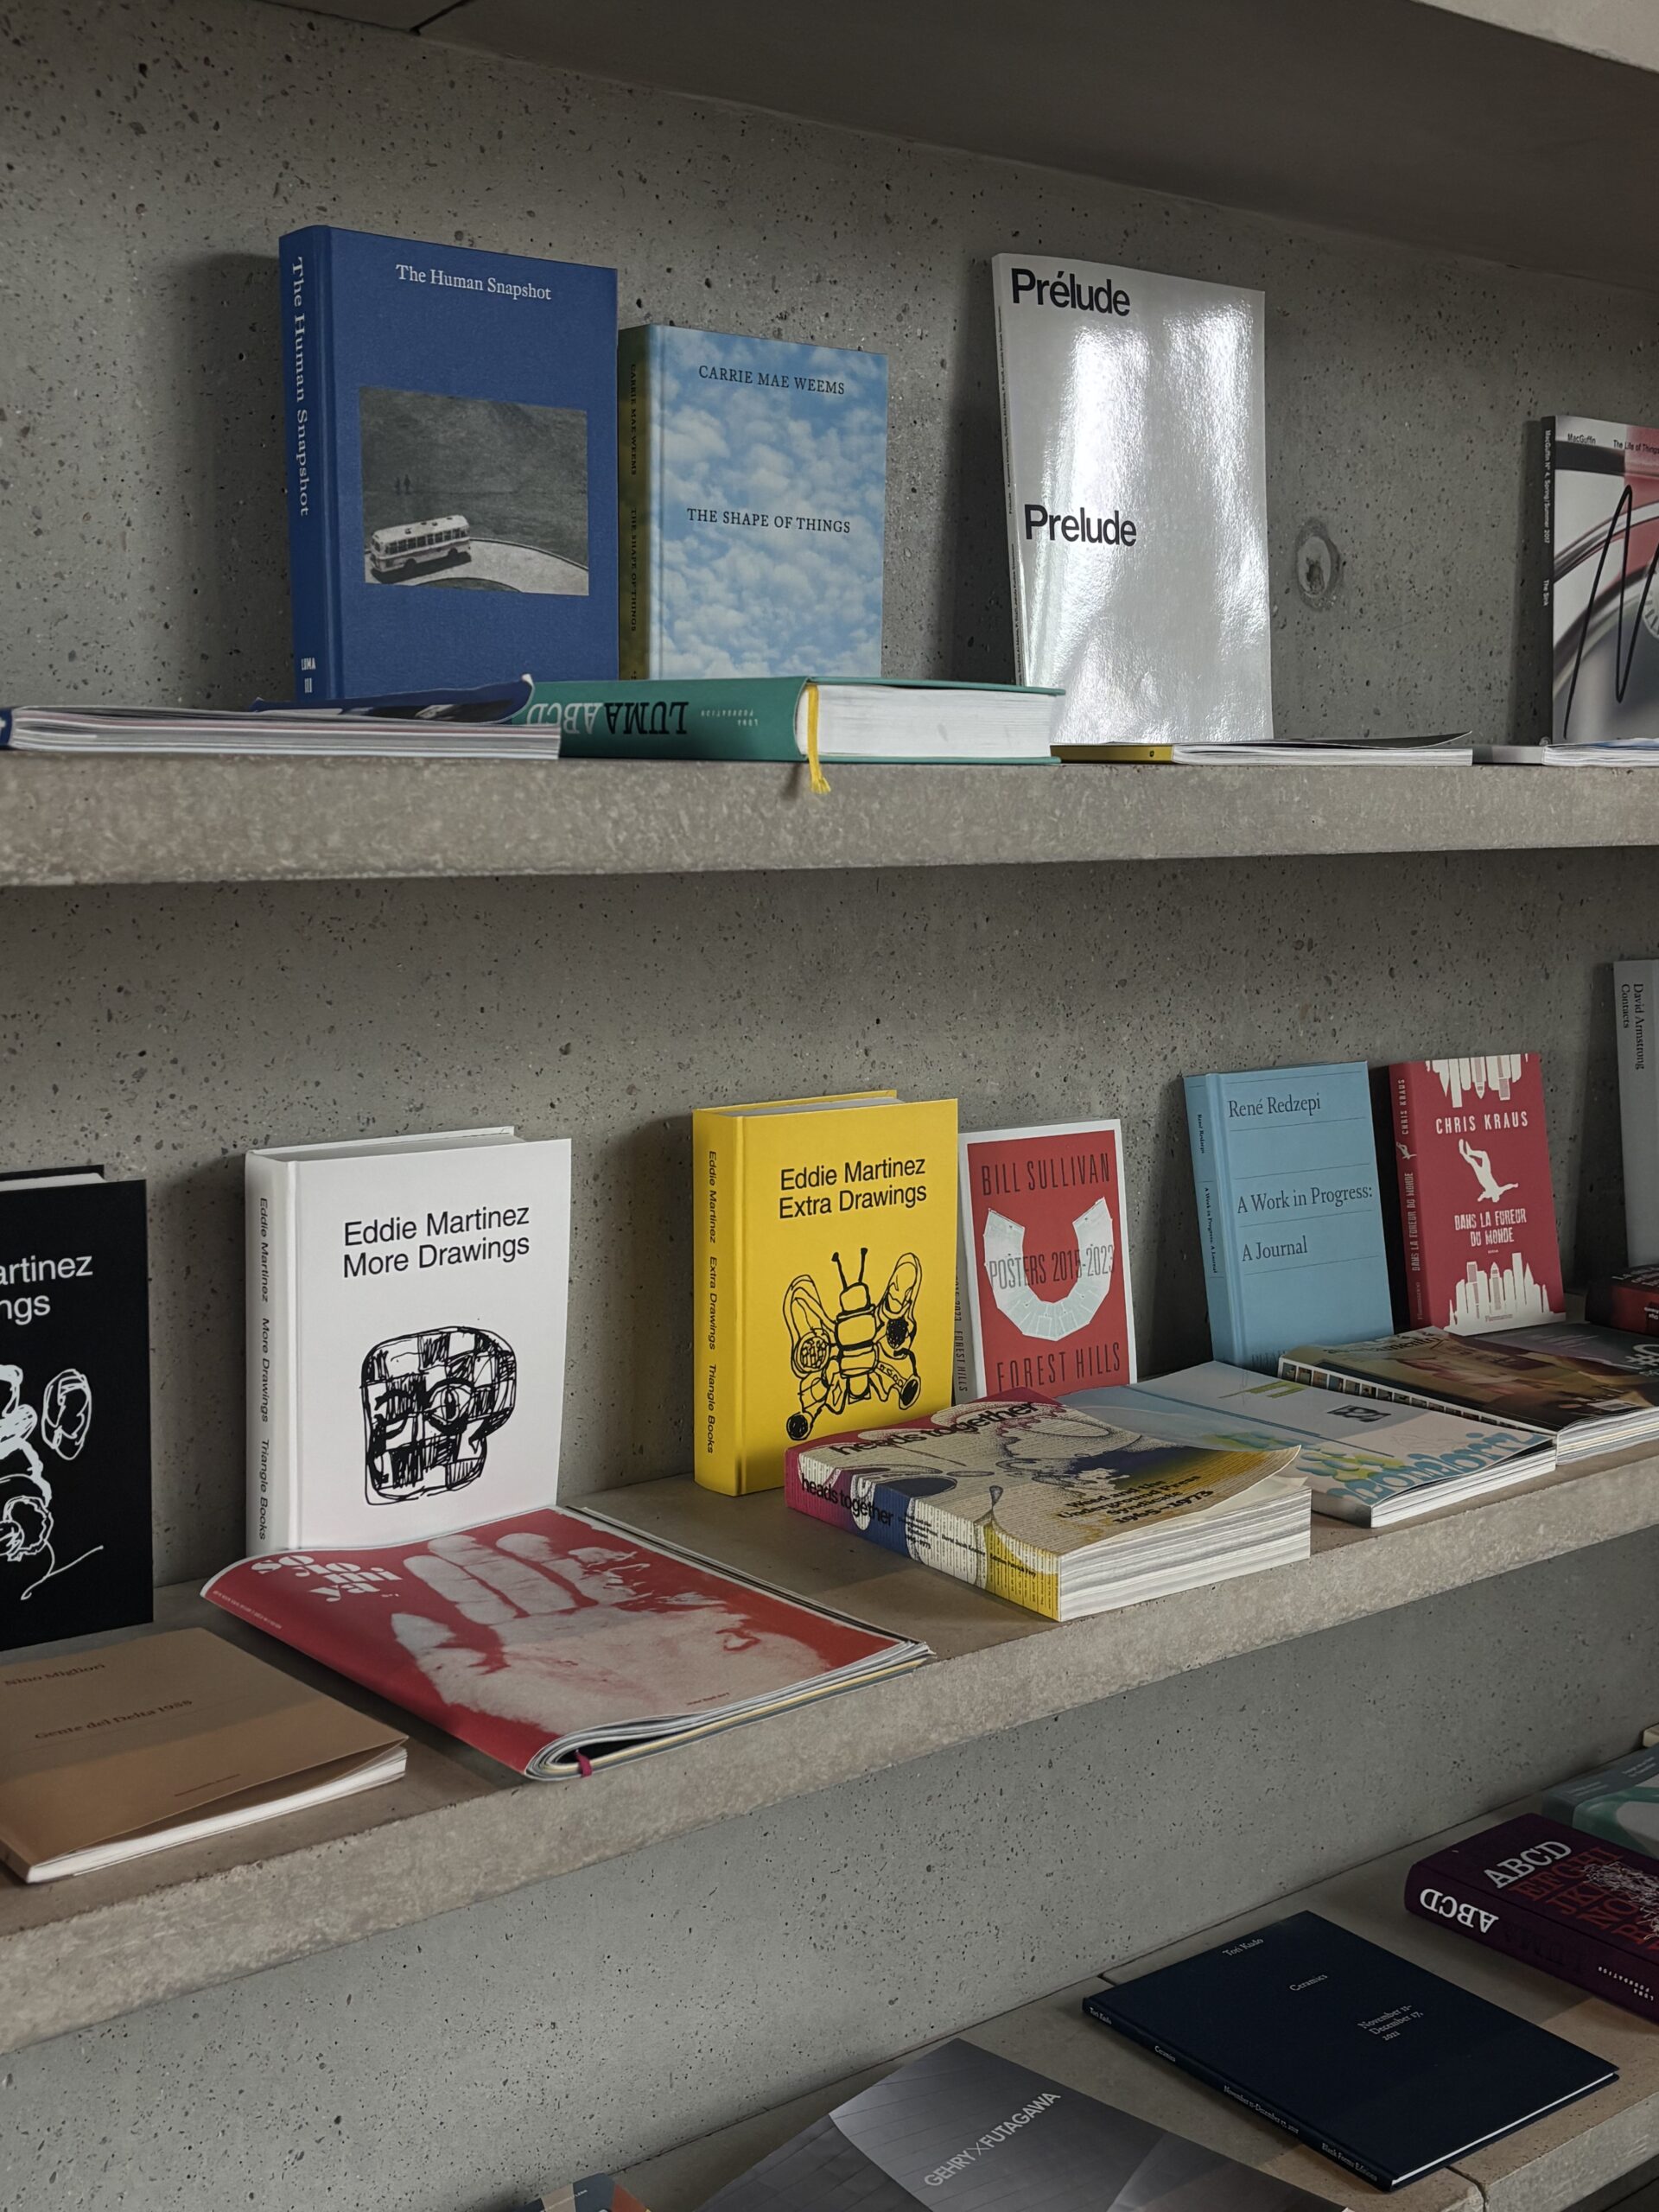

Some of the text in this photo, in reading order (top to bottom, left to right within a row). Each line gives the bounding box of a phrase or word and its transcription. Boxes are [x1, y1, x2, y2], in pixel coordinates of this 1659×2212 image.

[396, 264, 551, 300] The Human Snapshot
[1011, 267, 1131, 316] Prélude
[290, 257, 309, 517] The Human Snapshot
[698, 365, 845, 395] CARRIE MAE WEEMS
[1613, 439, 1623, 448] The
[687, 508, 851, 534] THE SHAPE OF THINGS
[1024, 504, 1136, 547] Prelude
[605, 702, 689, 734] LUMA
[1621, 983, 1631, 1029] Contacts
[1633, 983, 1645, 1071] David Armstrong
[1228, 1092, 1321, 1118] René Redzepi
[1397, 1078, 1409, 1135] CHRIS KRAUS
[1435, 1111, 1529, 1135] CHRIS KRAUS
[781, 1156, 925, 1192] Eddie Martinez
[982, 1153, 1109, 1196] BILL SULLIVAN
[779, 1184, 927, 1219] Extra Drawings
[1236, 1185, 1373, 1214] A Work in Progress:
[344, 1206, 530, 1246] Eddie Martinez
[1454, 1212, 1478, 1230] DANS
[1480, 1211, 1491, 1228] LA
[1485, 1227, 1515, 1245] MONDE
[344, 1234, 530, 1278] More Drawings
[1243, 1235, 1307, 1262] A Journal
[1409, 1241, 1419, 1250] LA
[988, 1244, 1114, 1290] POSTERS 2015-2023
[707, 1150, 718, 1454] Eddie Martinez Extra Drawings Triangle Books
[955, 1331, 965, 1363] FOREST
[258, 1197, 271, 1541] Eddie Martinez More Drawings Triangle Books
[957, 1366, 968, 1392] HILLS
[997, 1342, 1121, 1393] FOREST HILLS
[829, 1401, 1040, 1456] heads together
[800, 1472, 839, 1504] heads
[840, 1492, 893, 1527] together
[1057, 1475, 1202, 1519] Underground Press
[1065, 1480, 1166, 1509] Weed and the
[1106, 1491, 1184, 1516] Syndicate
[4, 1662, 106, 1688] Nino Migliori
[35, 1721, 84, 1740] Gente
[86, 1716, 111, 1732] del
[113, 1707, 156, 1728] Delta
[1484, 1840, 1572, 1890] ABCD
[1420, 1888, 1499, 1934] ABCD
[1222, 1938, 1264, 1957] Tori Kudo
[1289, 1974, 1328, 1991] Ceramics
[1357, 2009, 1401, 2030] November
[1369, 2014, 1411, 2035] December
[1382, 2031, 1401, 2041] 2021
[923, 2150, 976, 2188] GEHRY
[977, 2091, 1061, 2150] FUTAGAWA
